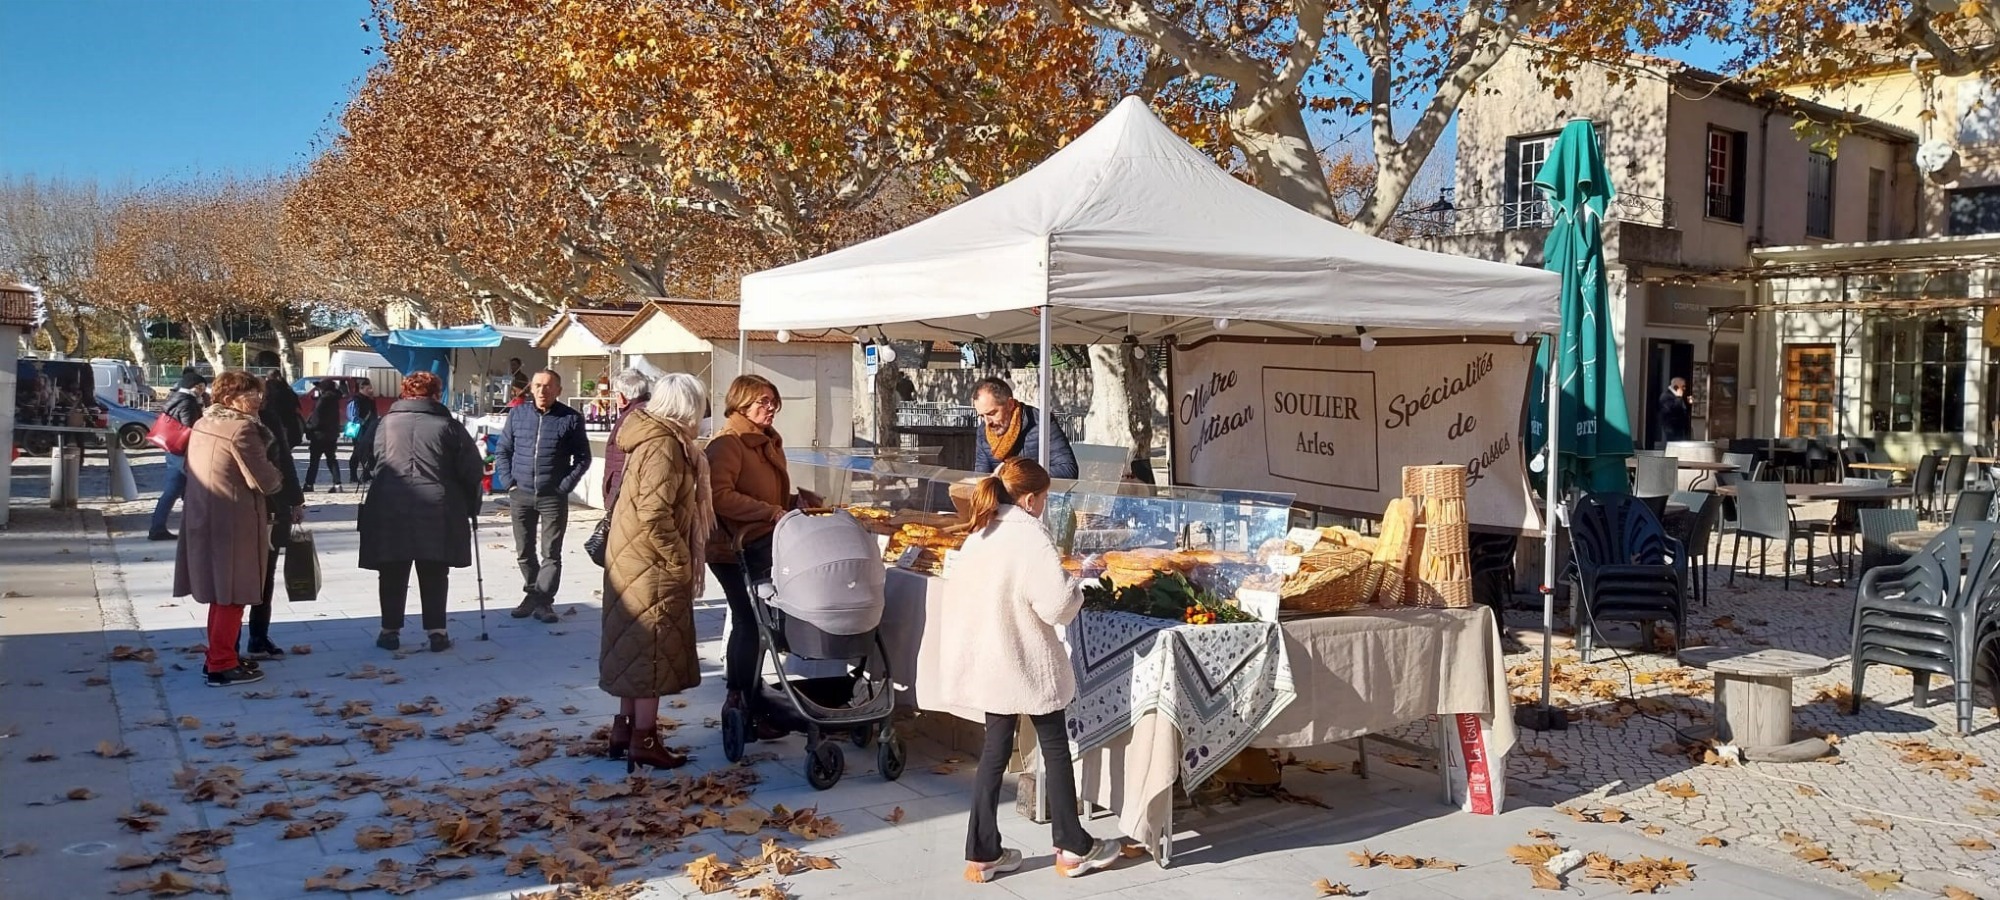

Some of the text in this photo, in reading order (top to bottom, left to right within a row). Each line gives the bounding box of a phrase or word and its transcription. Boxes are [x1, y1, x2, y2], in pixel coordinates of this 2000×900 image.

[1385, 351, 1494, 429] Spécialités
[1274, 391, 1361, 420] SOULIER
[1448, 412, 1477, 440] de
[1296, 431, 1335, 456] Arles
[1469, 748, 1482, 763] La
